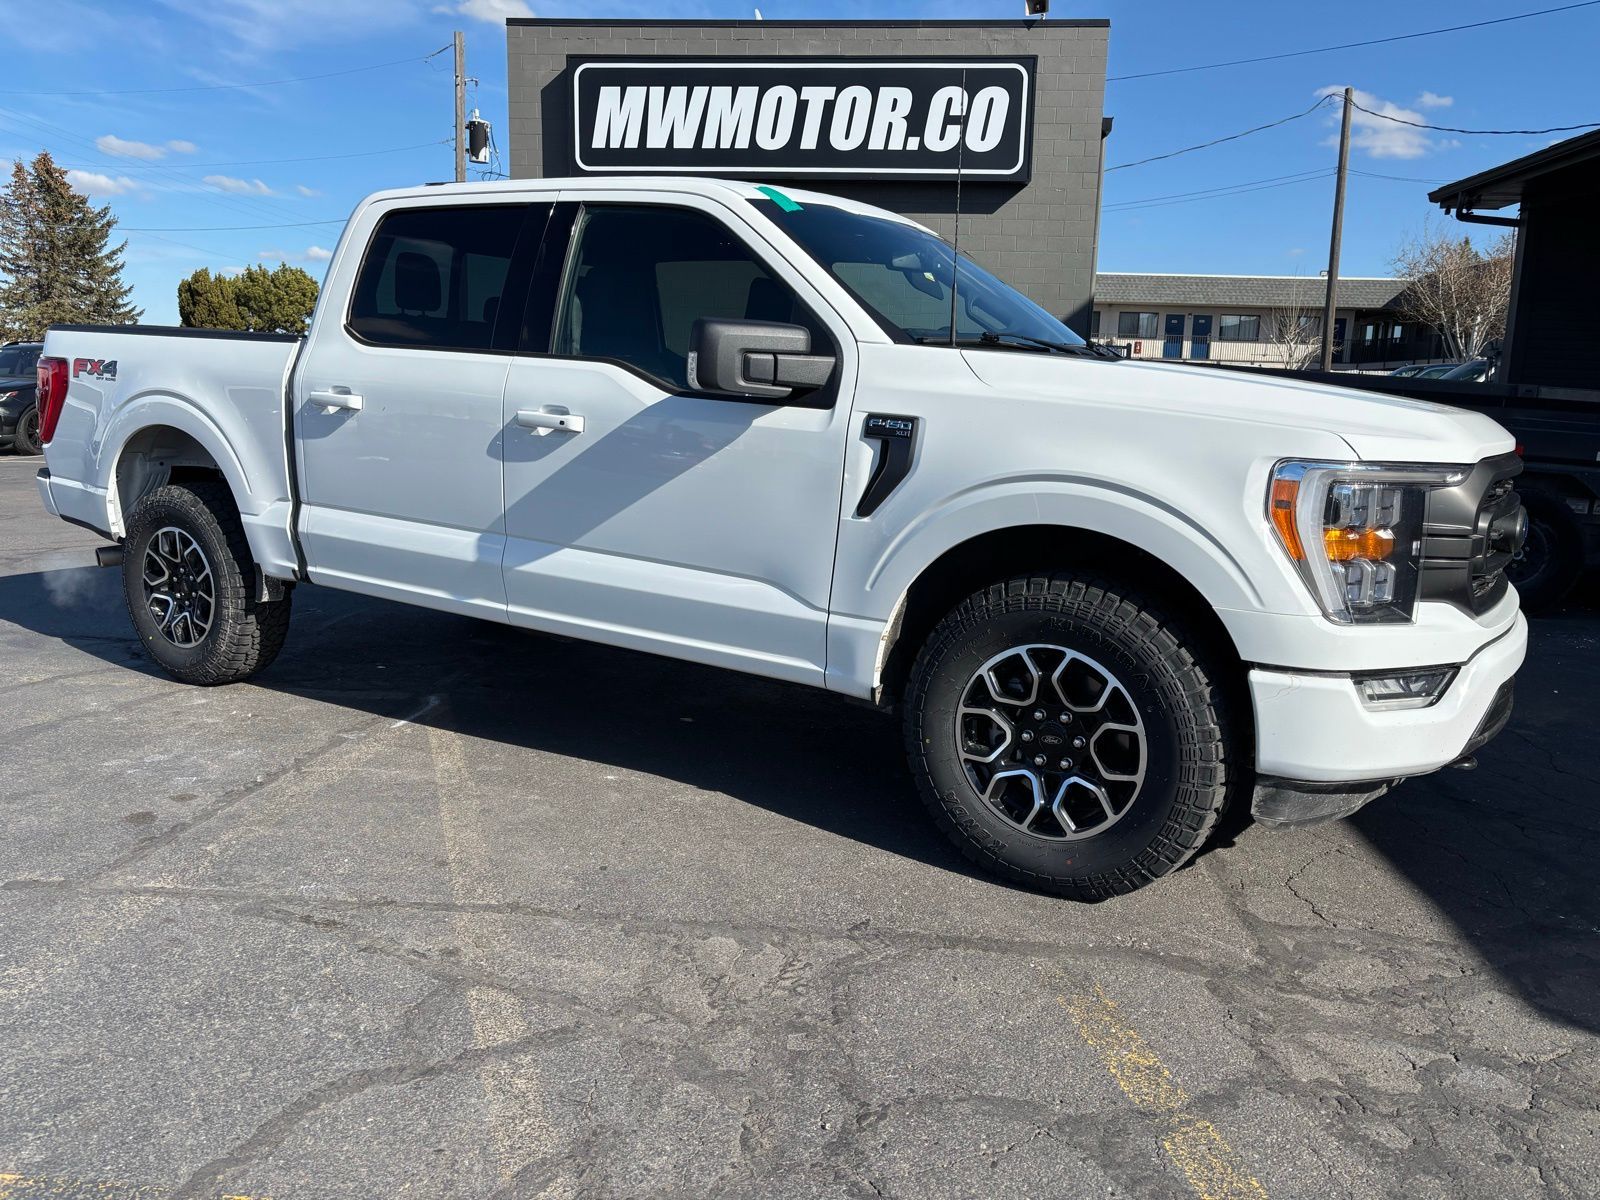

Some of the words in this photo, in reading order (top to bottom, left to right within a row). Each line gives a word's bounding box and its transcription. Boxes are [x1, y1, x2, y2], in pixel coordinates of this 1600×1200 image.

[591, 85, 1010, 153] MWMOTOR.CO
[73, 358, 117, 378] FX4
[869, 419, 912, 430] F-150
